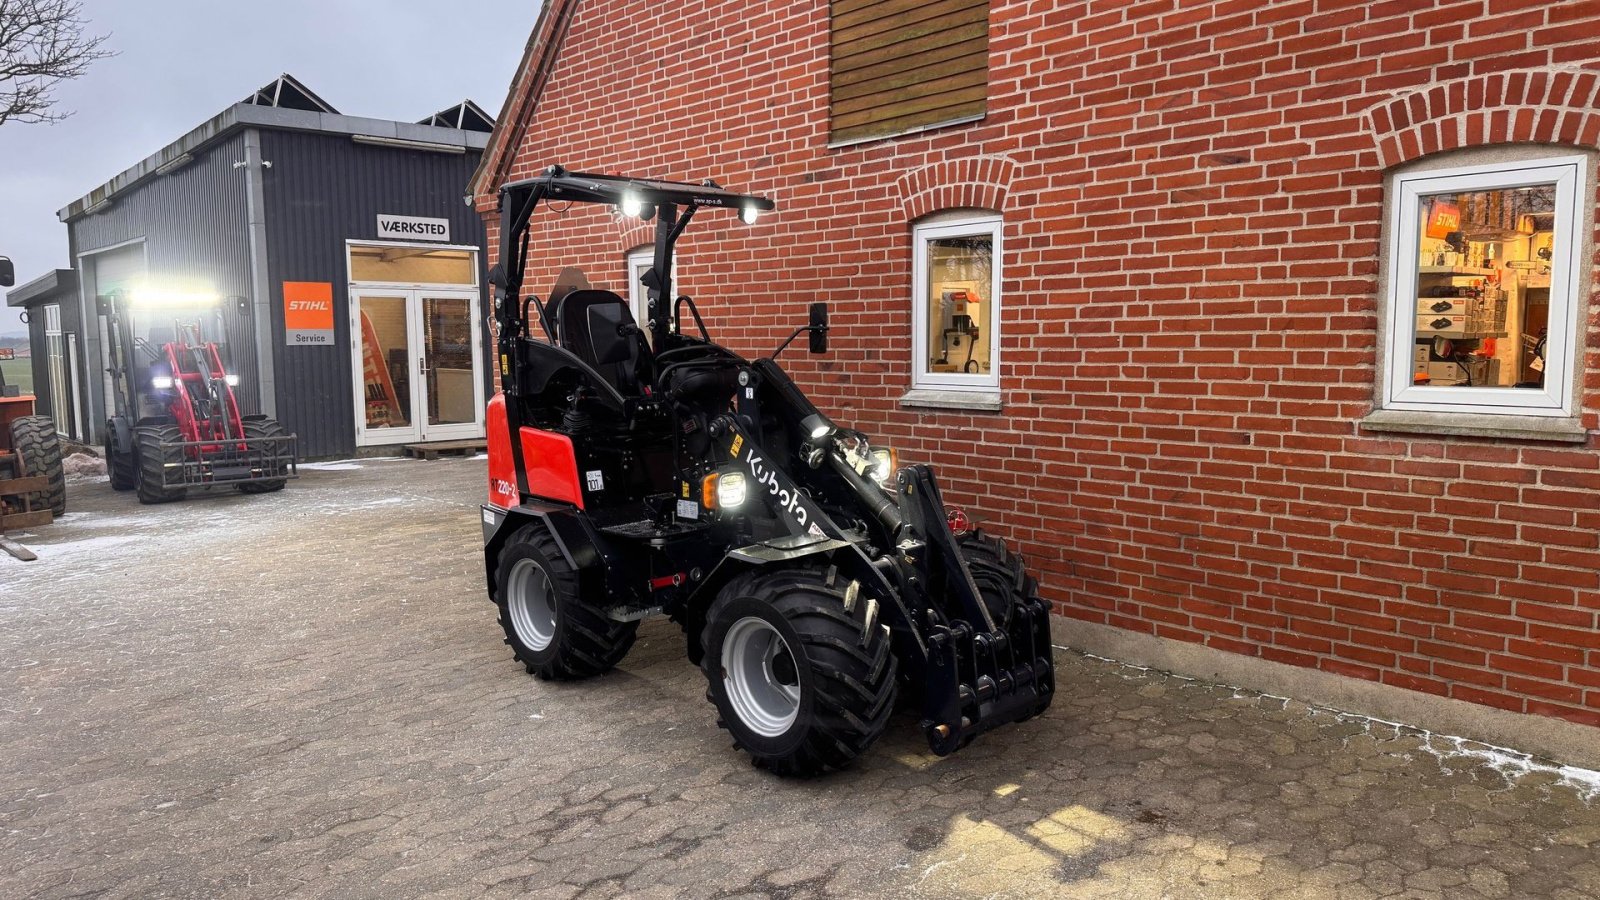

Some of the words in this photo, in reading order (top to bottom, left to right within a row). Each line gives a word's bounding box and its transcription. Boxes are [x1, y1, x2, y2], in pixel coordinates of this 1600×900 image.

[381, 220, 446, 235] VÆRKSTED
[289, 300, 329, 311] STIHL
[295, 333, 326, 343] Service
[746, 448, 807, 526] Kubota
